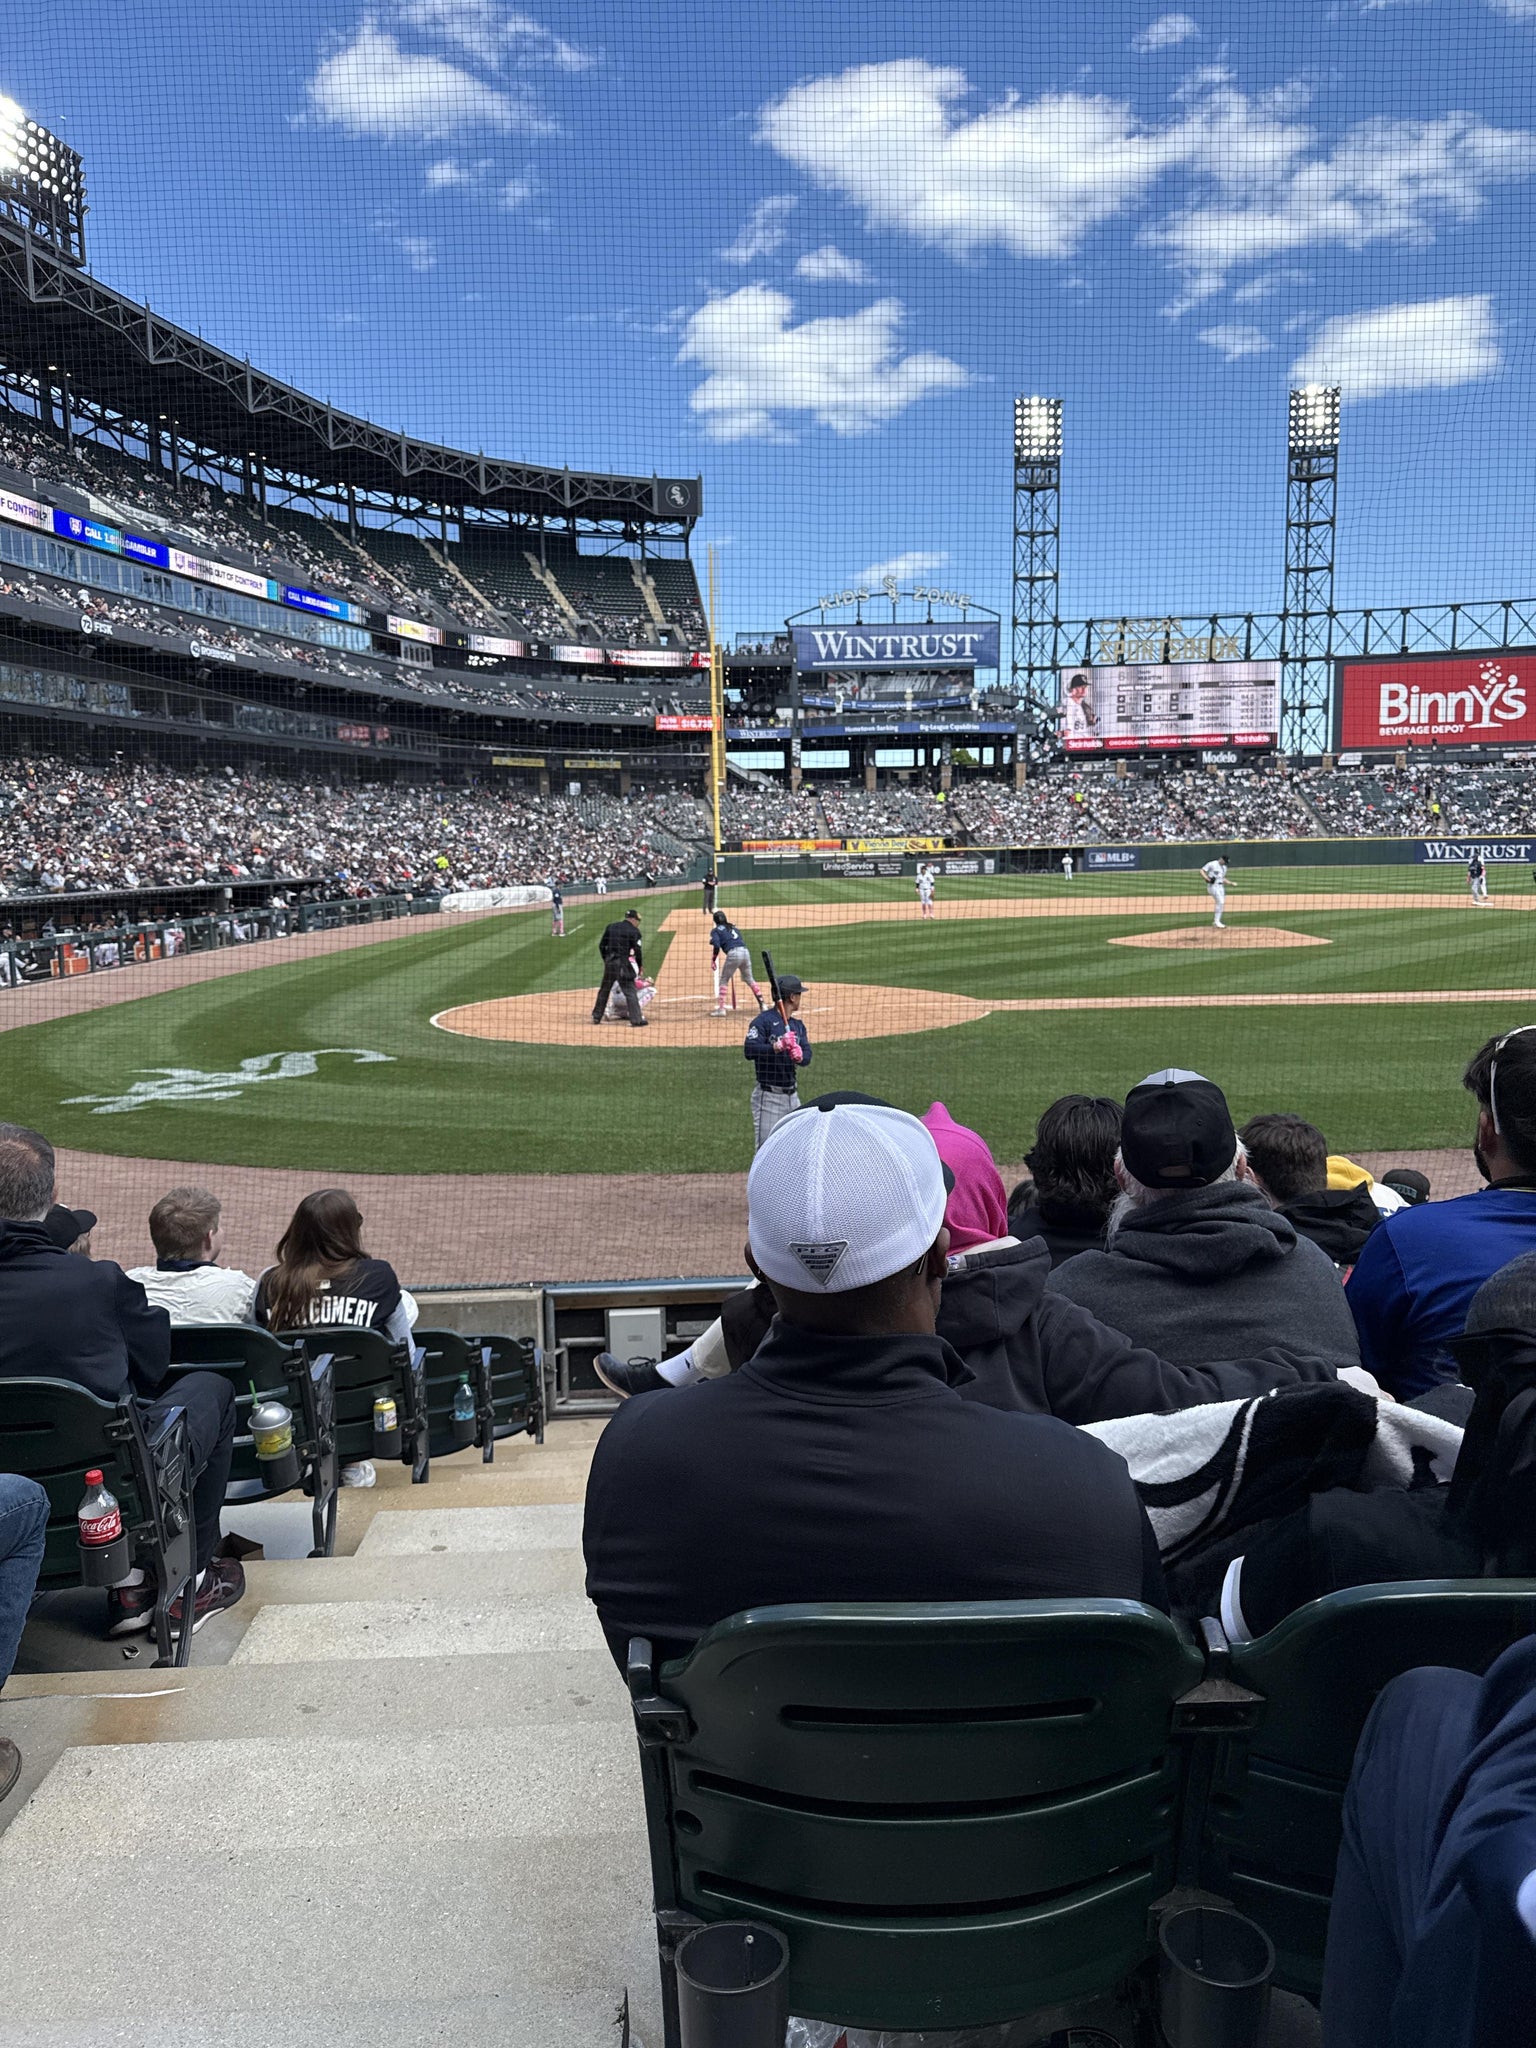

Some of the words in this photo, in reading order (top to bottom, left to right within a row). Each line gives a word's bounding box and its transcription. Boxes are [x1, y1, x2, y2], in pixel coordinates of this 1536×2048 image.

[7, 499, 47, 522] CONTROL?
[85, 526, 102, 541] CALL
[214, 568, 226, 579] OUT
[818, 586, 870, 613] KIDS
[913, 585, 971, 610] ZONE
[93, 621, 114, 635] FISK
[1100, 618, 1184, 635] CAESARS
[811, 630, 979, 660] WINTRUST
[1099, 636, 1240, 663] SPORTSBOOK
[1378, 725, 1430, 736] BEVERAGE
[1431, 724, 1466, 735] DEPOT
[1202, 750, 1237, 763] Modelo
[1107, 852, 1136, 863] MLB+
[1424, 842, 1531, 859] WINTRUST
[266, 1295, 379, 1328] GOMERY
